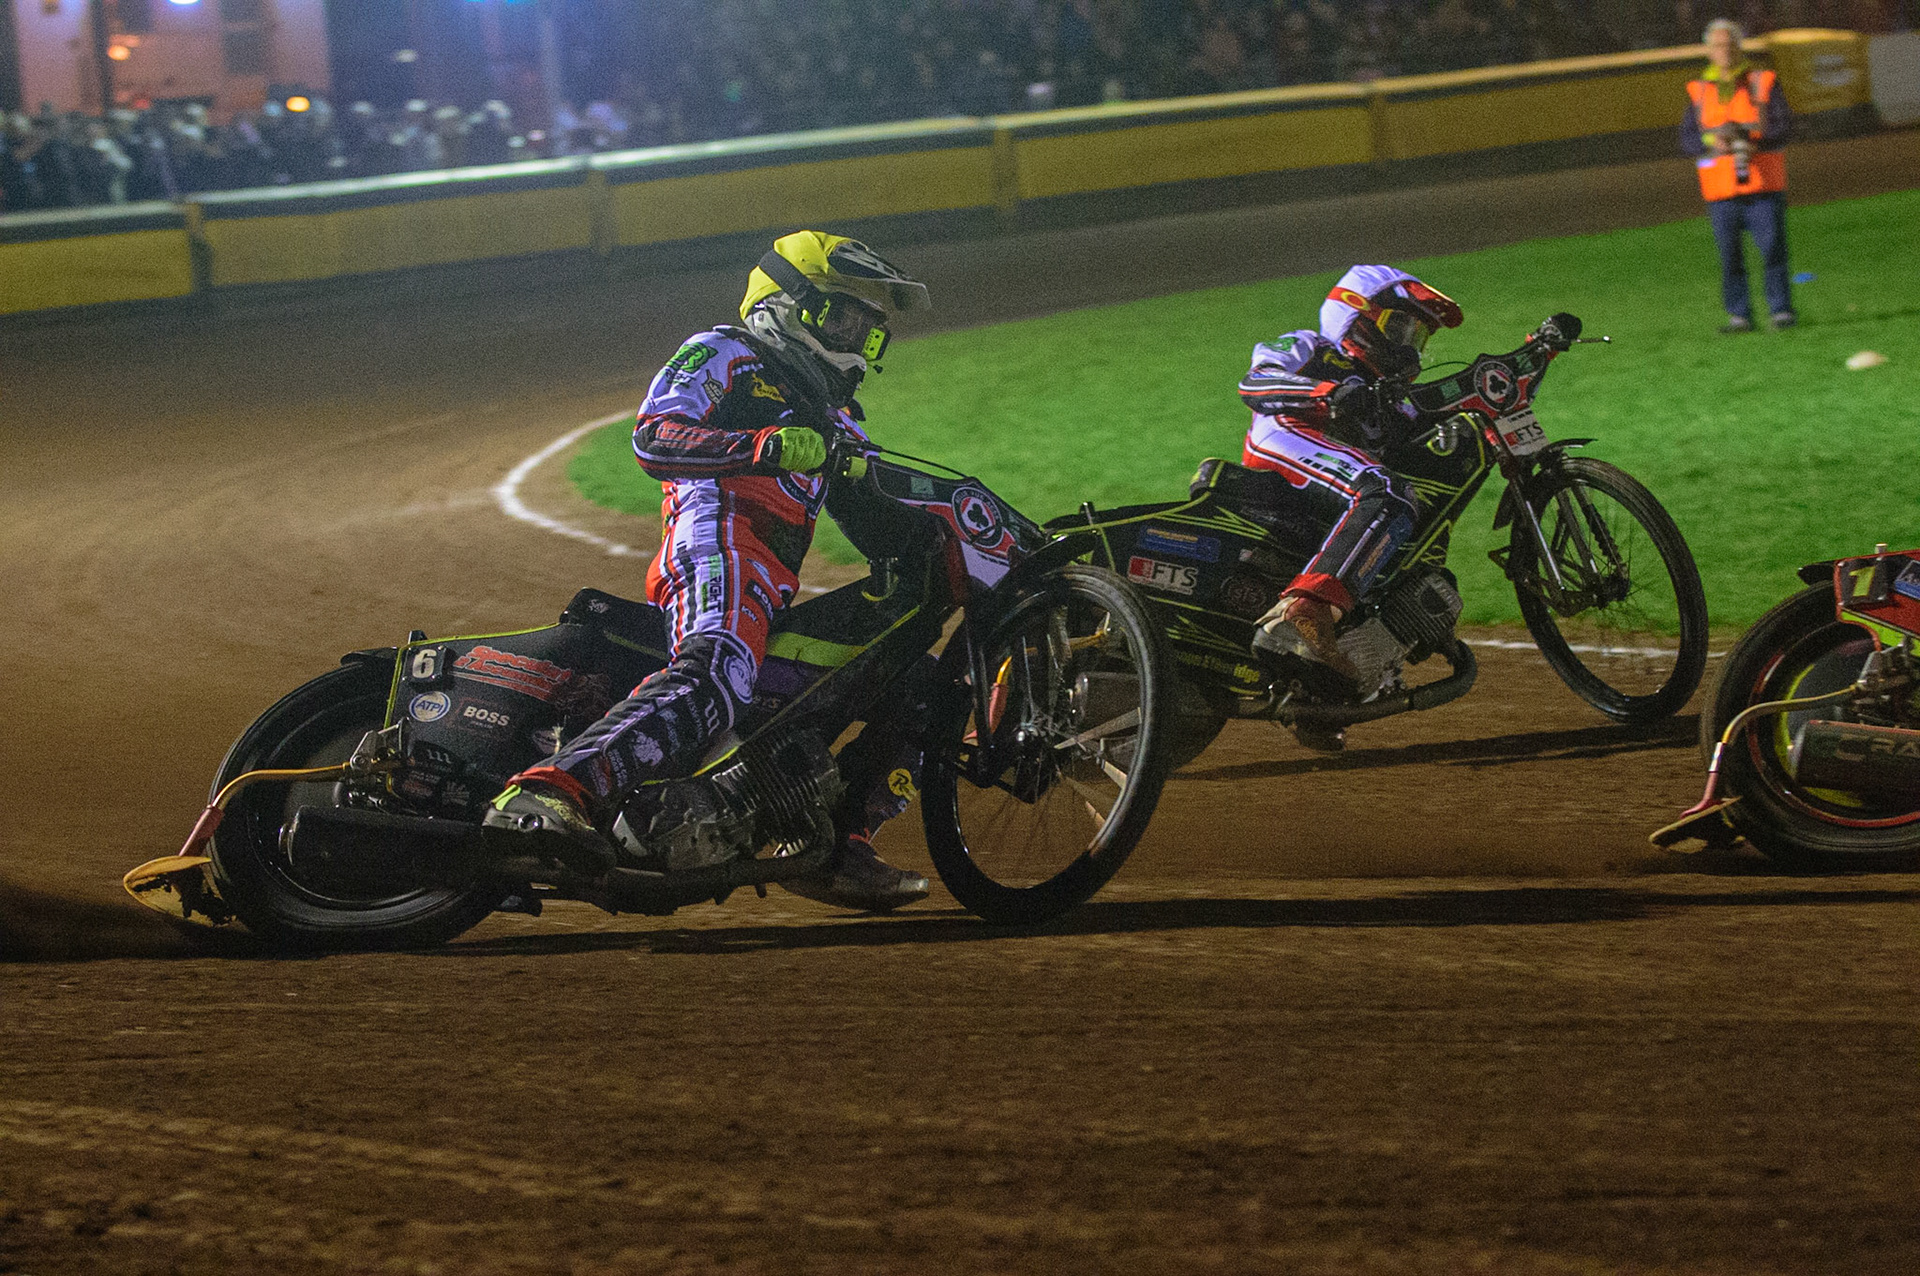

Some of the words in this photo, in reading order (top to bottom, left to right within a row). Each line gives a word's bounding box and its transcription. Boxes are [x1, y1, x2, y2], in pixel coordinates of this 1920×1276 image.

[1515, 421, 1543, 441] FTS
[1151, 562, 1198, 588] FTS
[1849, 565, 1876, 597] 1
[412, 649, 437, 679] 6
[414, 700, 444, 713] ATPI
[463, 705, 511, 727] BOSS
